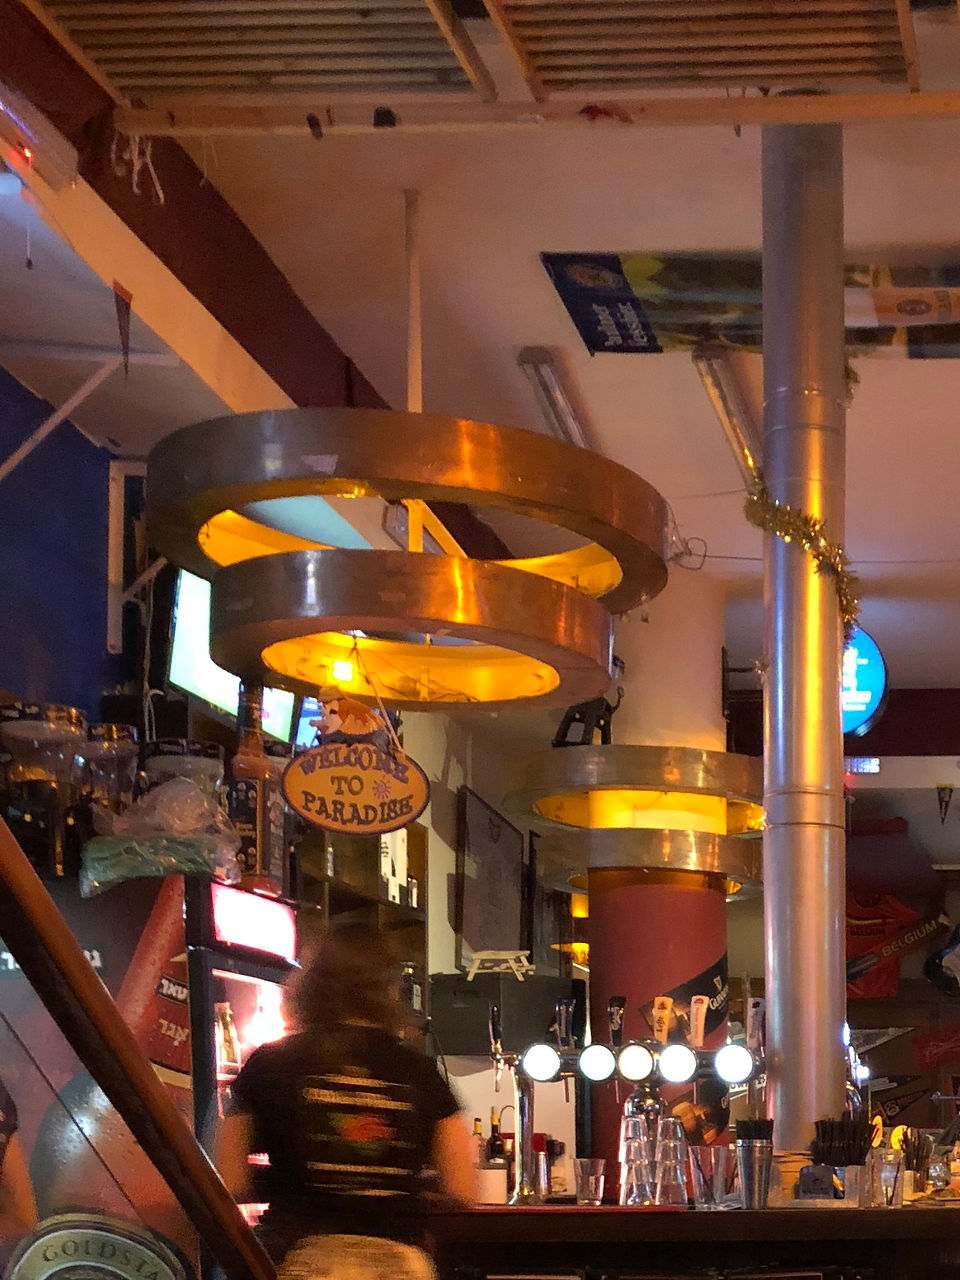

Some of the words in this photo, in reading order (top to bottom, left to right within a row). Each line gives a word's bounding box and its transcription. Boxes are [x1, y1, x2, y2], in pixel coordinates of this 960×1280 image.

[299, 744, 410, 785] WELCOME
[330, 774, 364, 796] TO
[302, 790, 414, 826] PARADISE
[882, 920, 937, 957] BELGIUM
